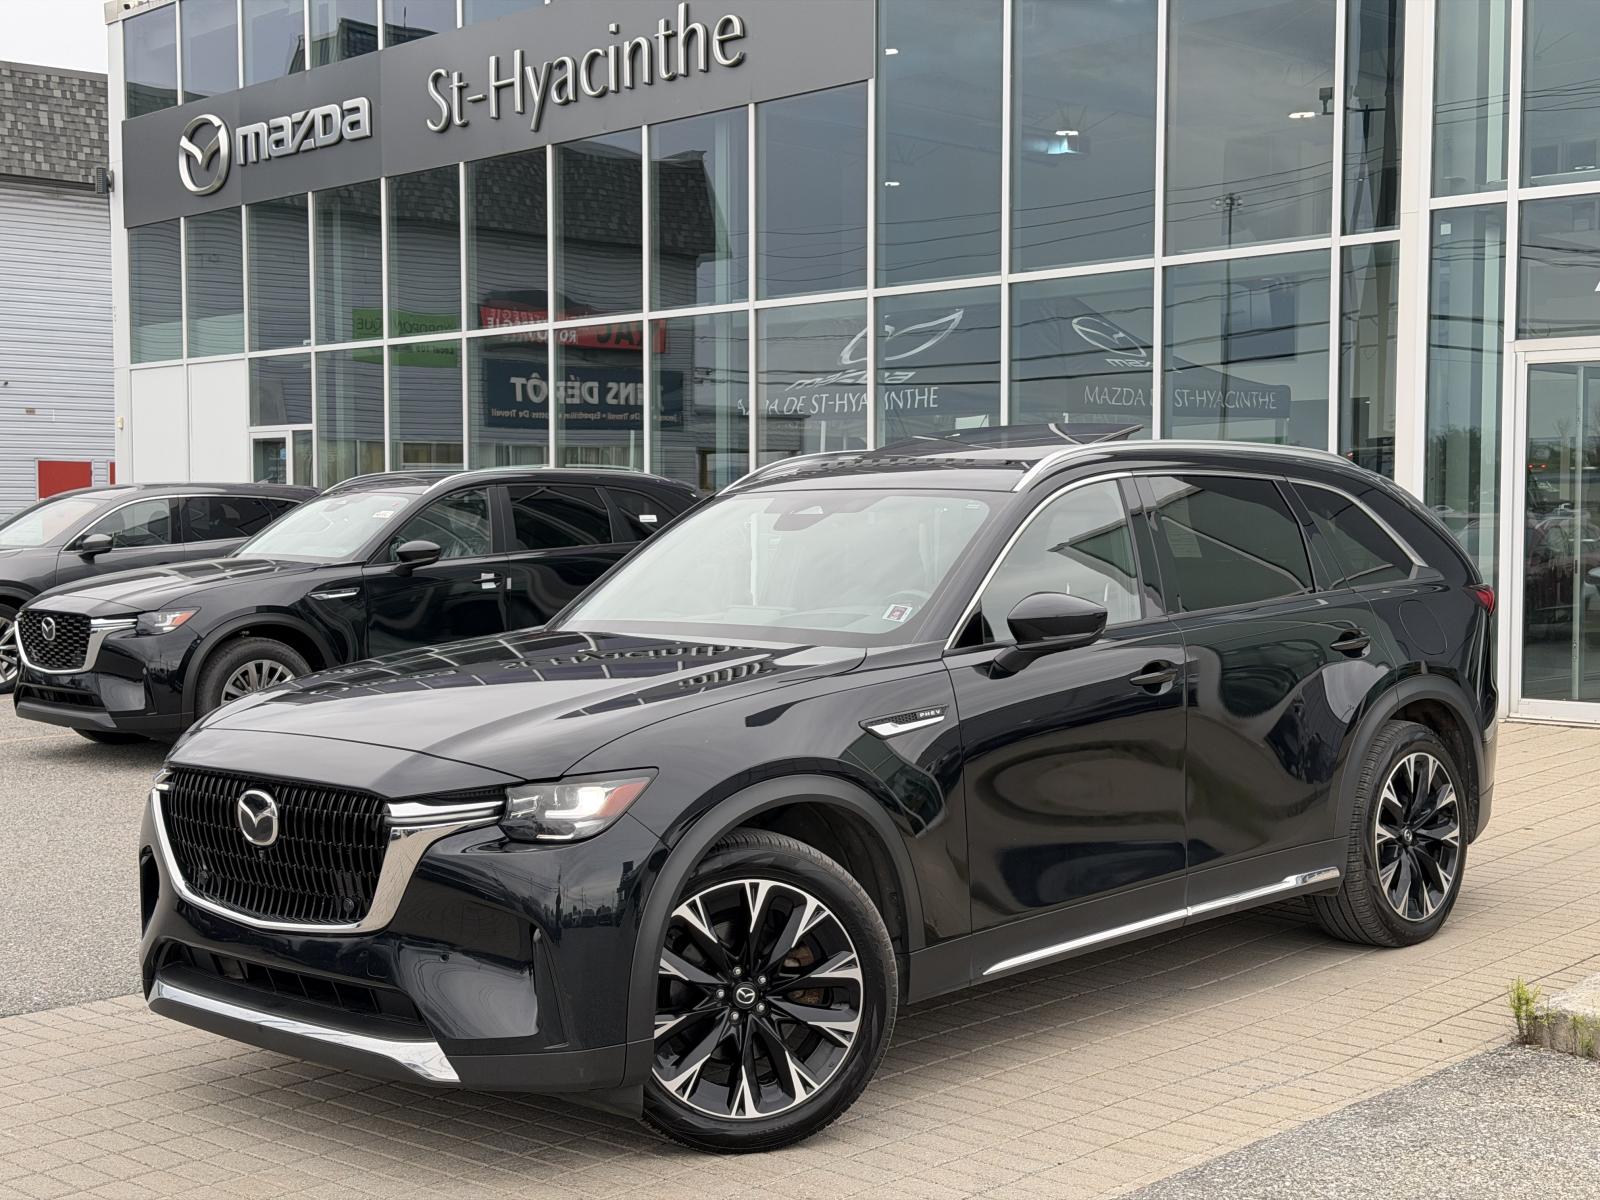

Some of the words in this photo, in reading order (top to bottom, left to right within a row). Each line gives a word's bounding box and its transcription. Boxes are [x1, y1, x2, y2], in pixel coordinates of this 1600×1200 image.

[235, 96, 371, 165] mazda
[426, 2, 745, 133] St-Hyacinthe
[808, 387, 939, 414] ST-HYAINTHE
[1084, 385, 1146, 407] MAZDA
[1174, 388, 1278, 409] ST-HYACINTHE
[919, 708, 941, 718] PHEV
